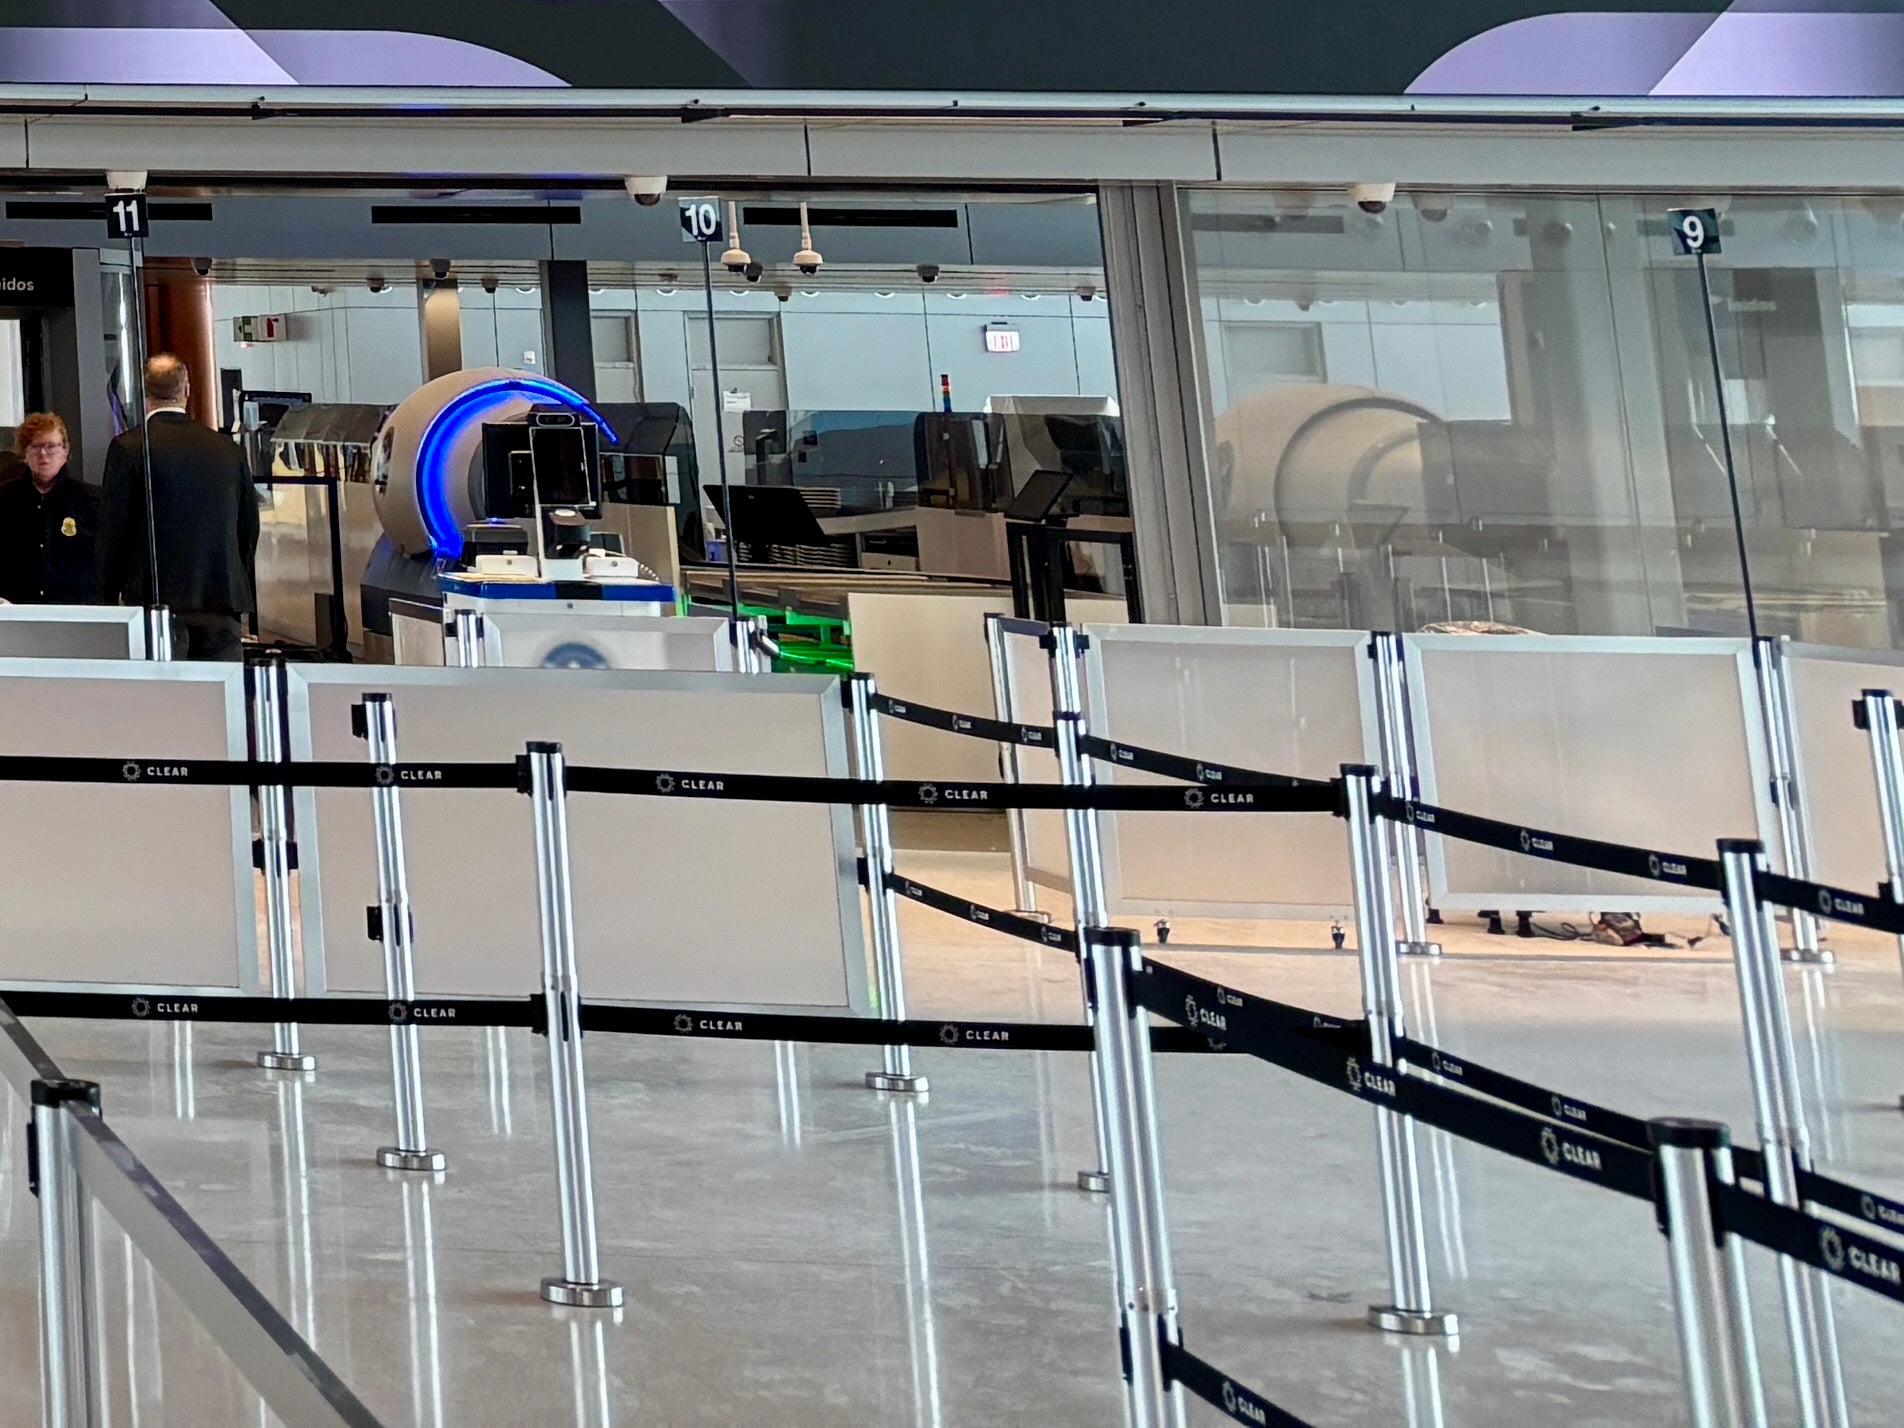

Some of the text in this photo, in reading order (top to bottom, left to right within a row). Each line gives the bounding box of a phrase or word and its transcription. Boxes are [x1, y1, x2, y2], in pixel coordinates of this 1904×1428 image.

[113, 200, 139, 232] 11
[685, 204, 716, 235] 10
[1682, 215, 1704, 248] 9
[147, 766, 188, 777] CLEAR
[400, 770, 442, 780] CLEAR
[681, 779, 1254, 804] CLEAR CLEAR CLEAR
[157, 1002, 456, 1018] CLEAR CLEAR
[700, 1019, 1009, 1041] CLEAR CLEAR
[1199, 1008, 1602, 1170] CLEAR CLEAR CLEAR
[1847, 1245, 1902, 1285] CLEAR
